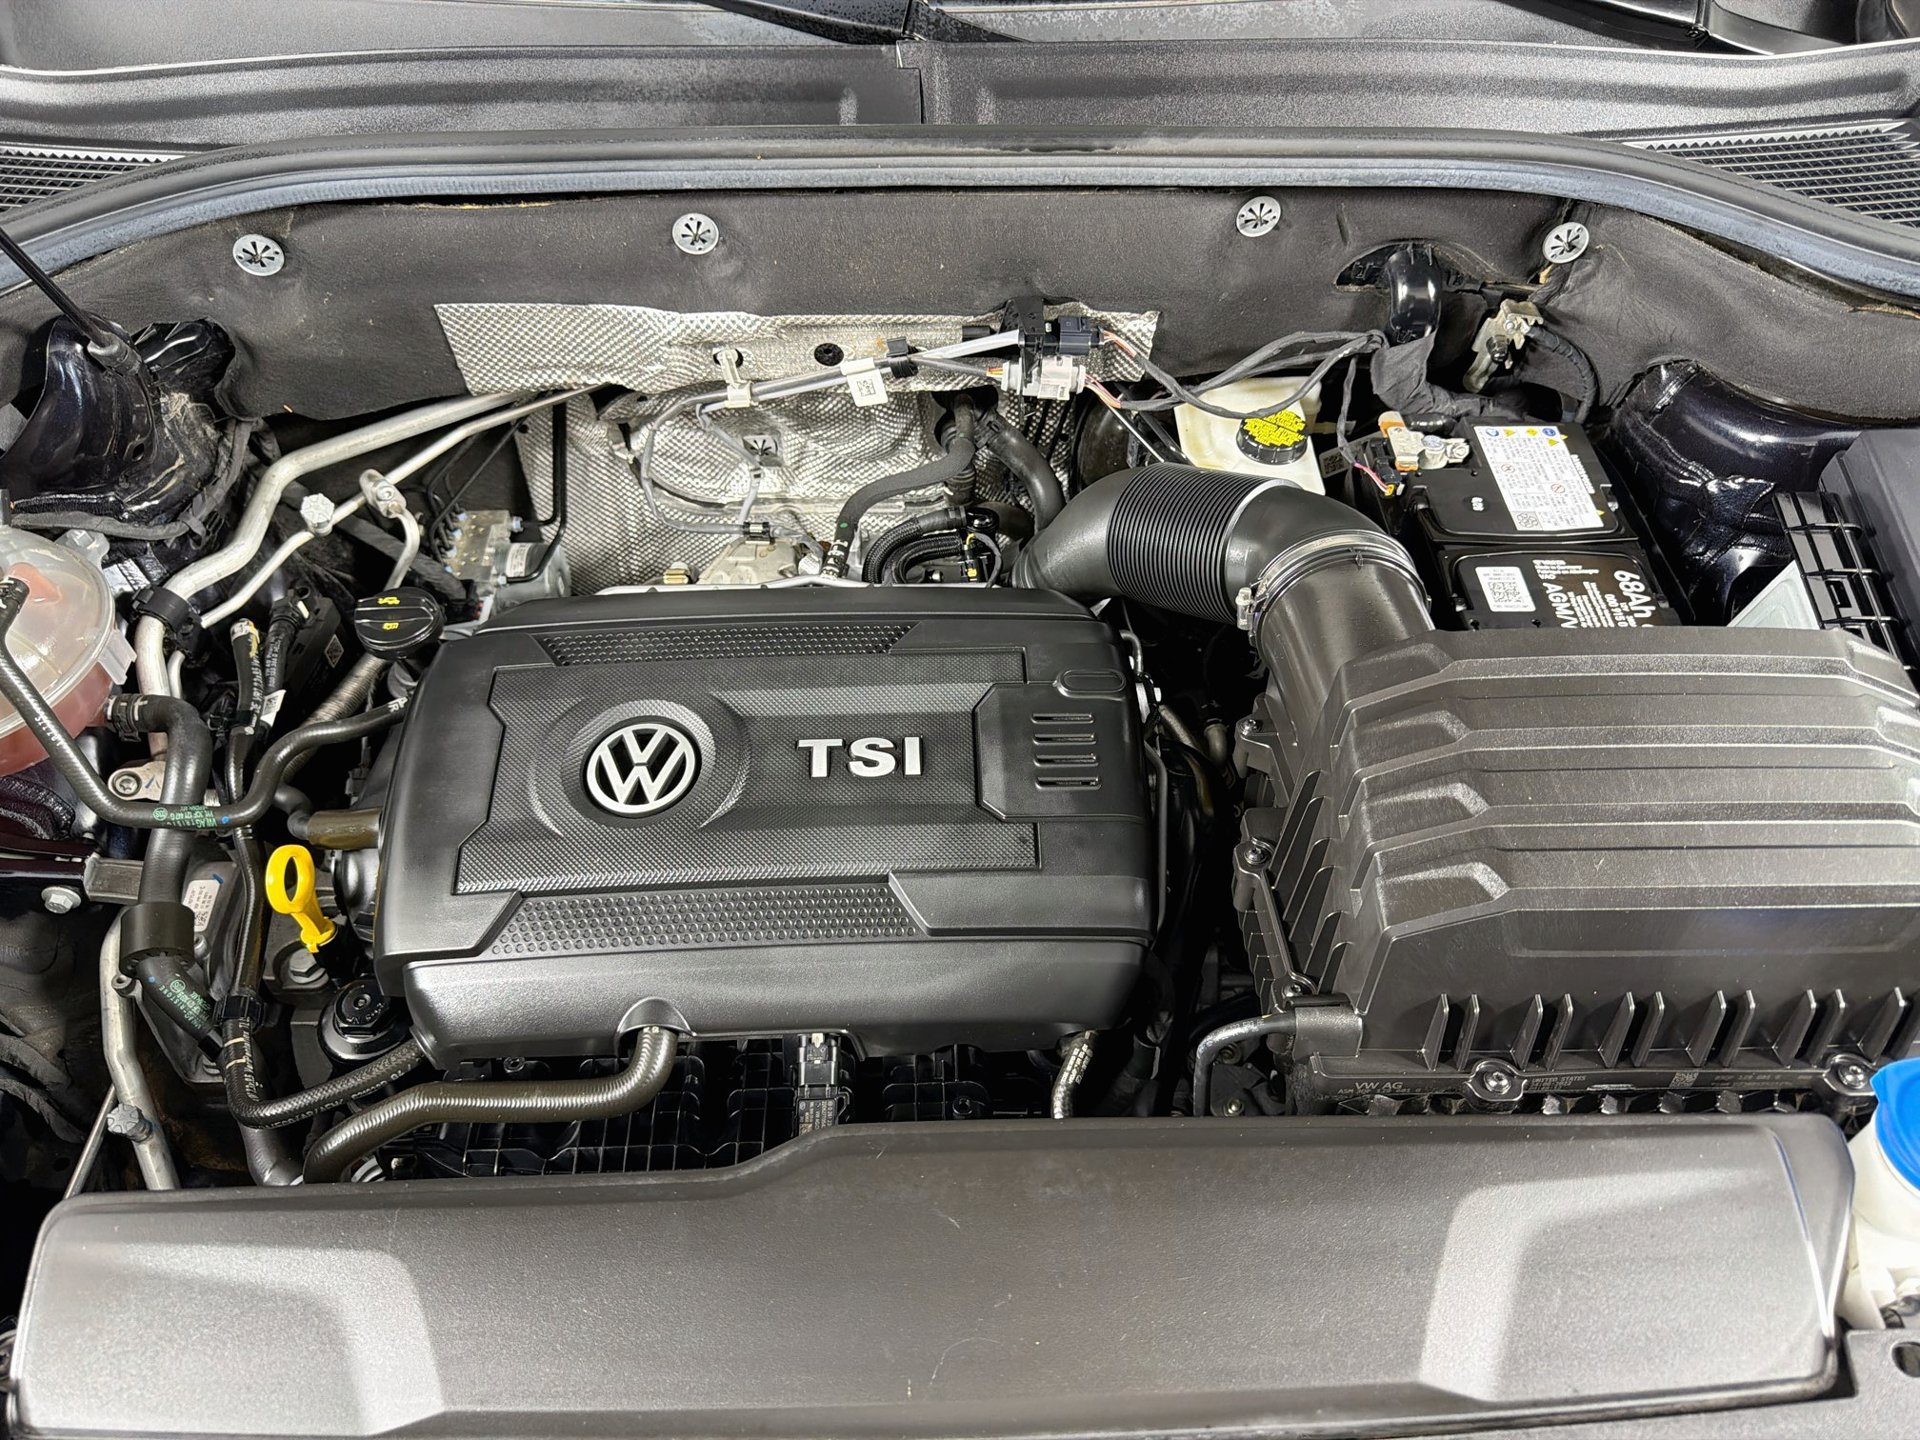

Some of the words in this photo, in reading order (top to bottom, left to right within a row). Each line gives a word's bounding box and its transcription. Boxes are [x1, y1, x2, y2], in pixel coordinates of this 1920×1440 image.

[1604, 593, 1619, 607] 000
[1612, 606, 1625, 621] 915
[1613, 570, 1656, 618] 68Ah
[797, 736, 923, 778] TSI
[1354, 1082, 1380, 1090] VW
